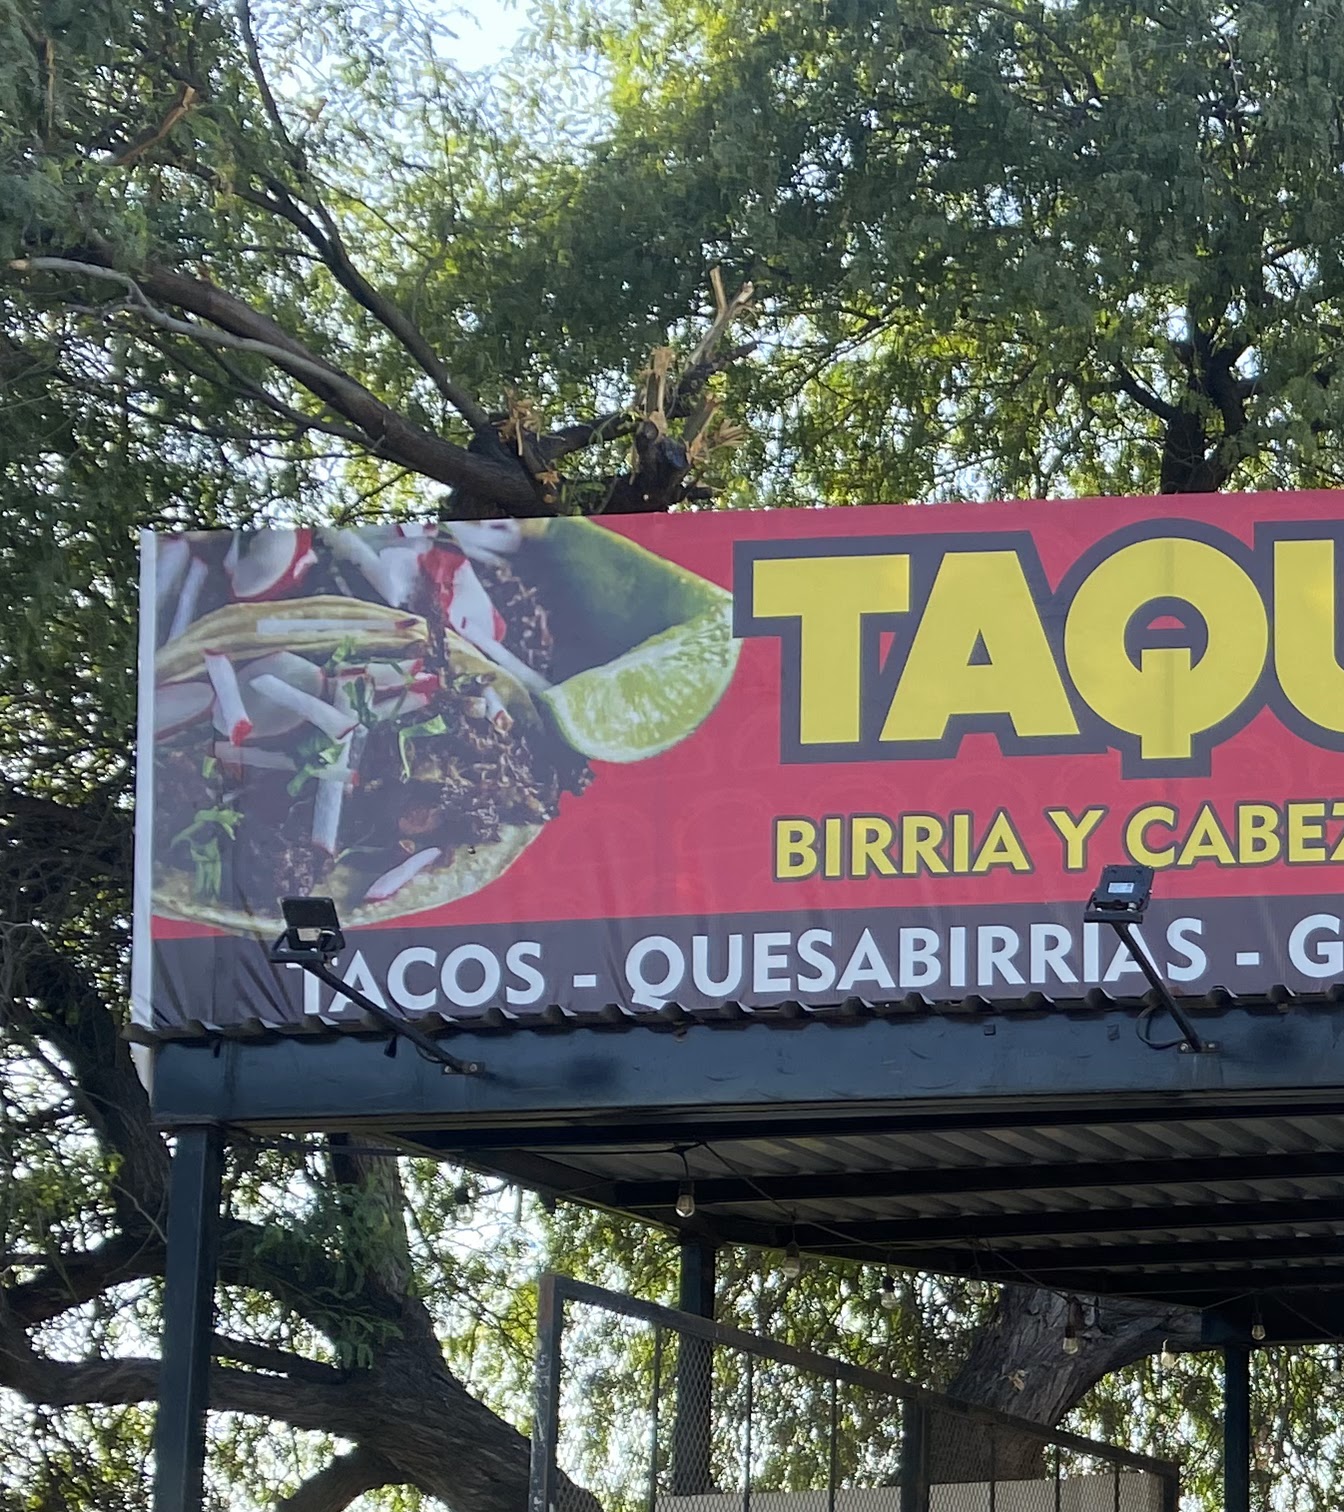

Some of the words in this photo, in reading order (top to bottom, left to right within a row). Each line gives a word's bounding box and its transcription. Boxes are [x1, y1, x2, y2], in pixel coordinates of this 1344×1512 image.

[776, 814, 1028, 880] BIRRIA
[1050, 809, 1102, 870] Y
[286, 940, 546, 1016] TACOS
[624, 917, 1208, 1003] QUESABIRRIAS
